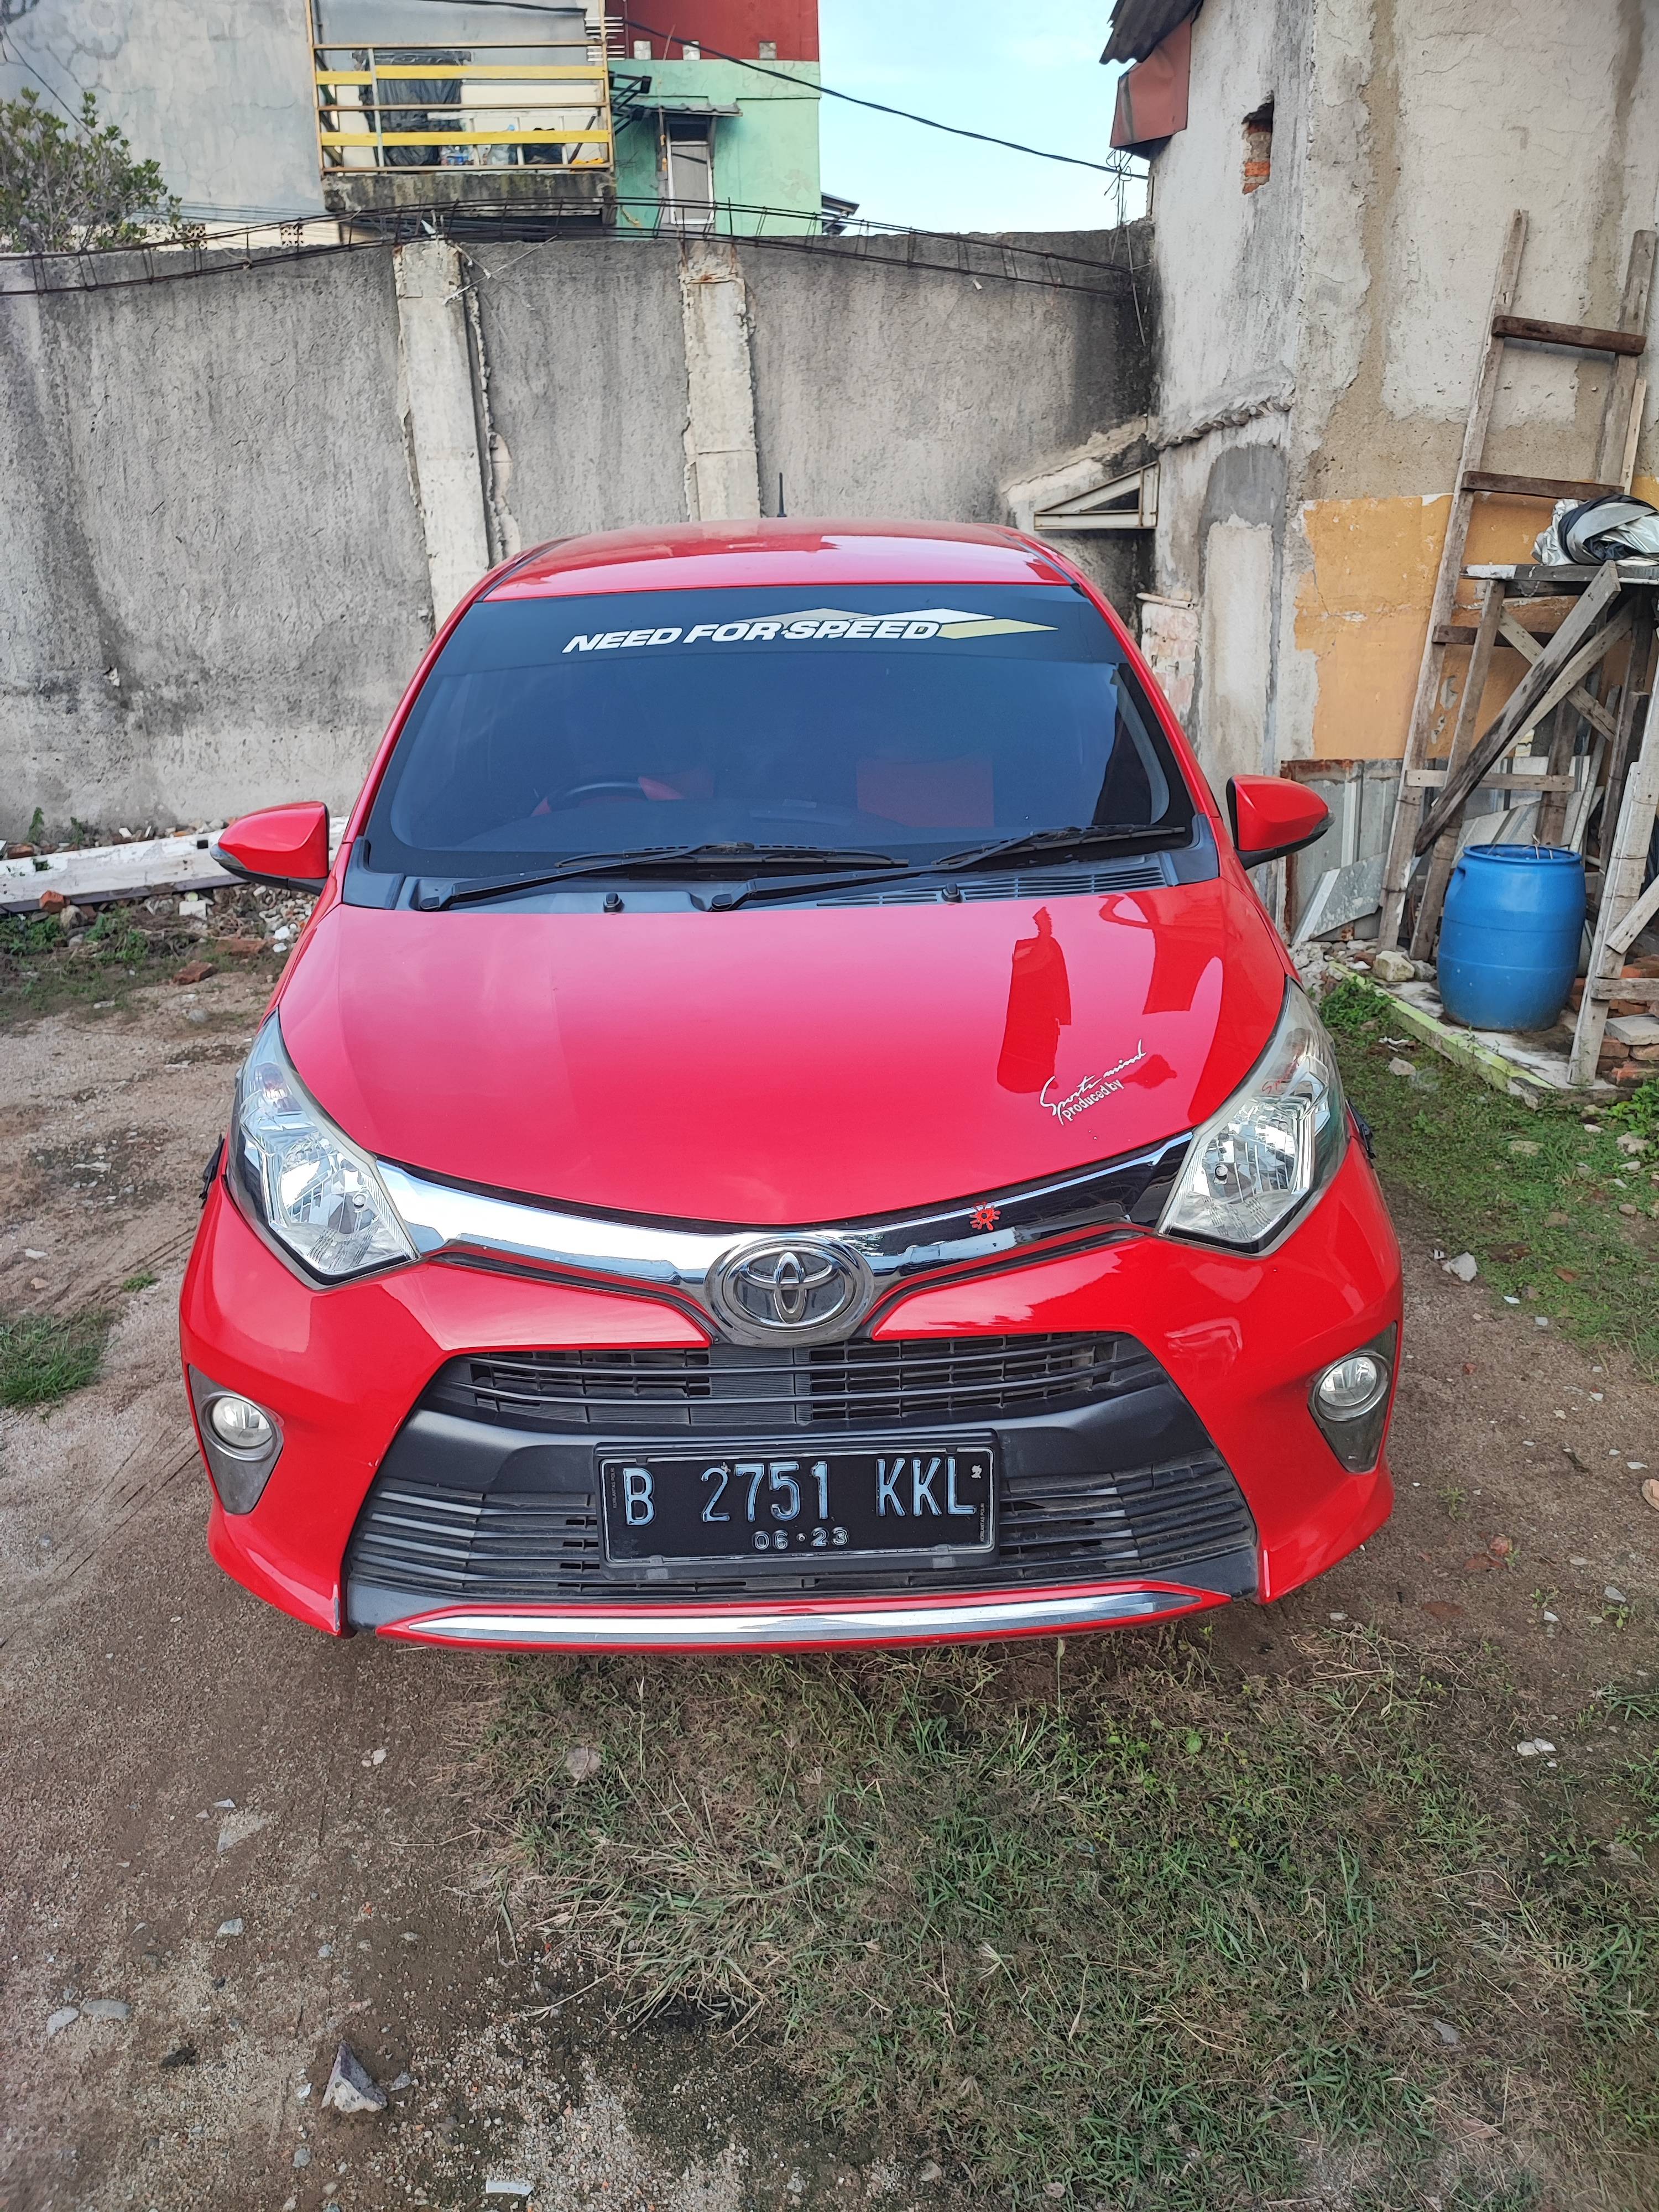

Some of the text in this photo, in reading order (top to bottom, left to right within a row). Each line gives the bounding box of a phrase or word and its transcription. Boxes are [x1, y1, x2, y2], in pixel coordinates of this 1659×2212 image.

[561, 620, 940, 654] NEED FOR SPEED
[1061, 1079, 1125, 1122] produced by
[623, 1457, 976, 1526] B 2751 KKL
